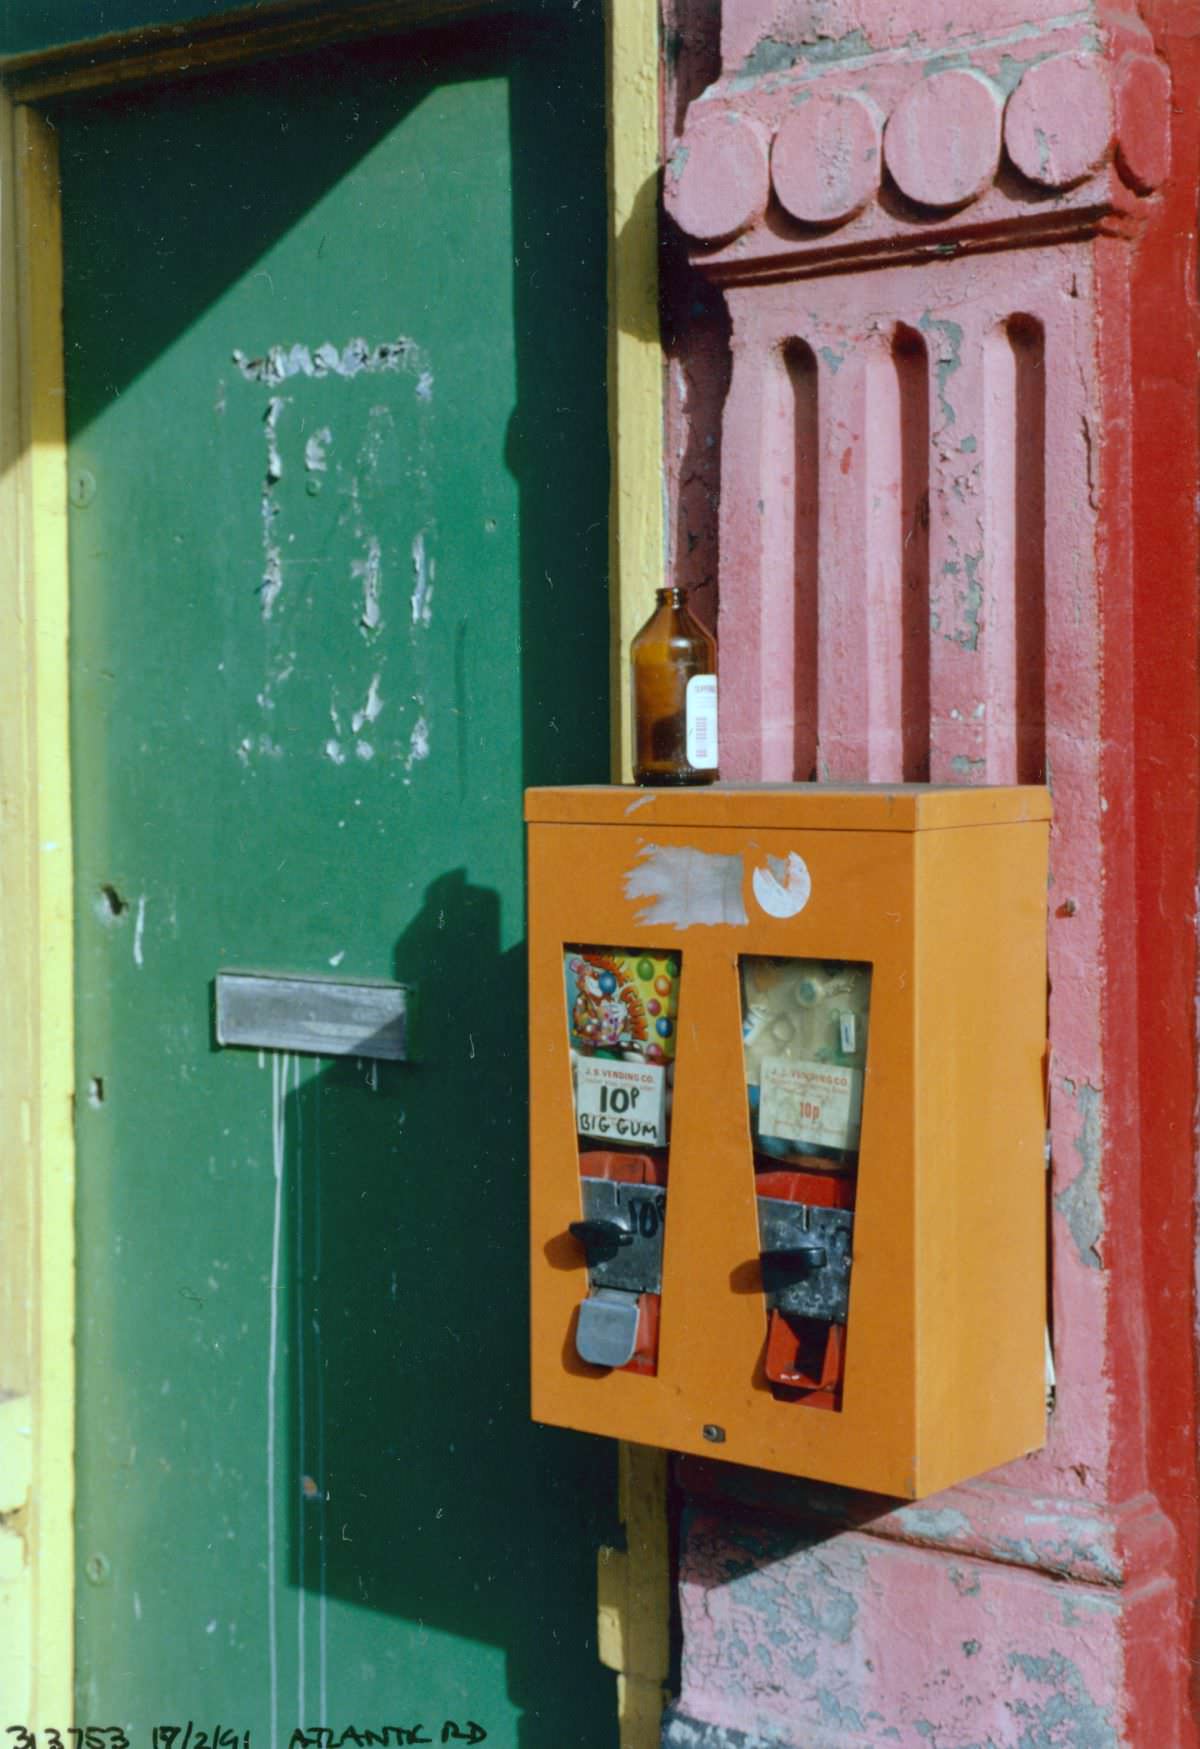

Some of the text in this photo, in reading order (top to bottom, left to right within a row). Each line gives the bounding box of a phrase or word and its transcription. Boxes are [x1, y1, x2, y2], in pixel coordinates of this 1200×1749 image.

[603, 1070, 640, 1082] VENDING
[580, 1113, 657, 1139] BIG GUM
